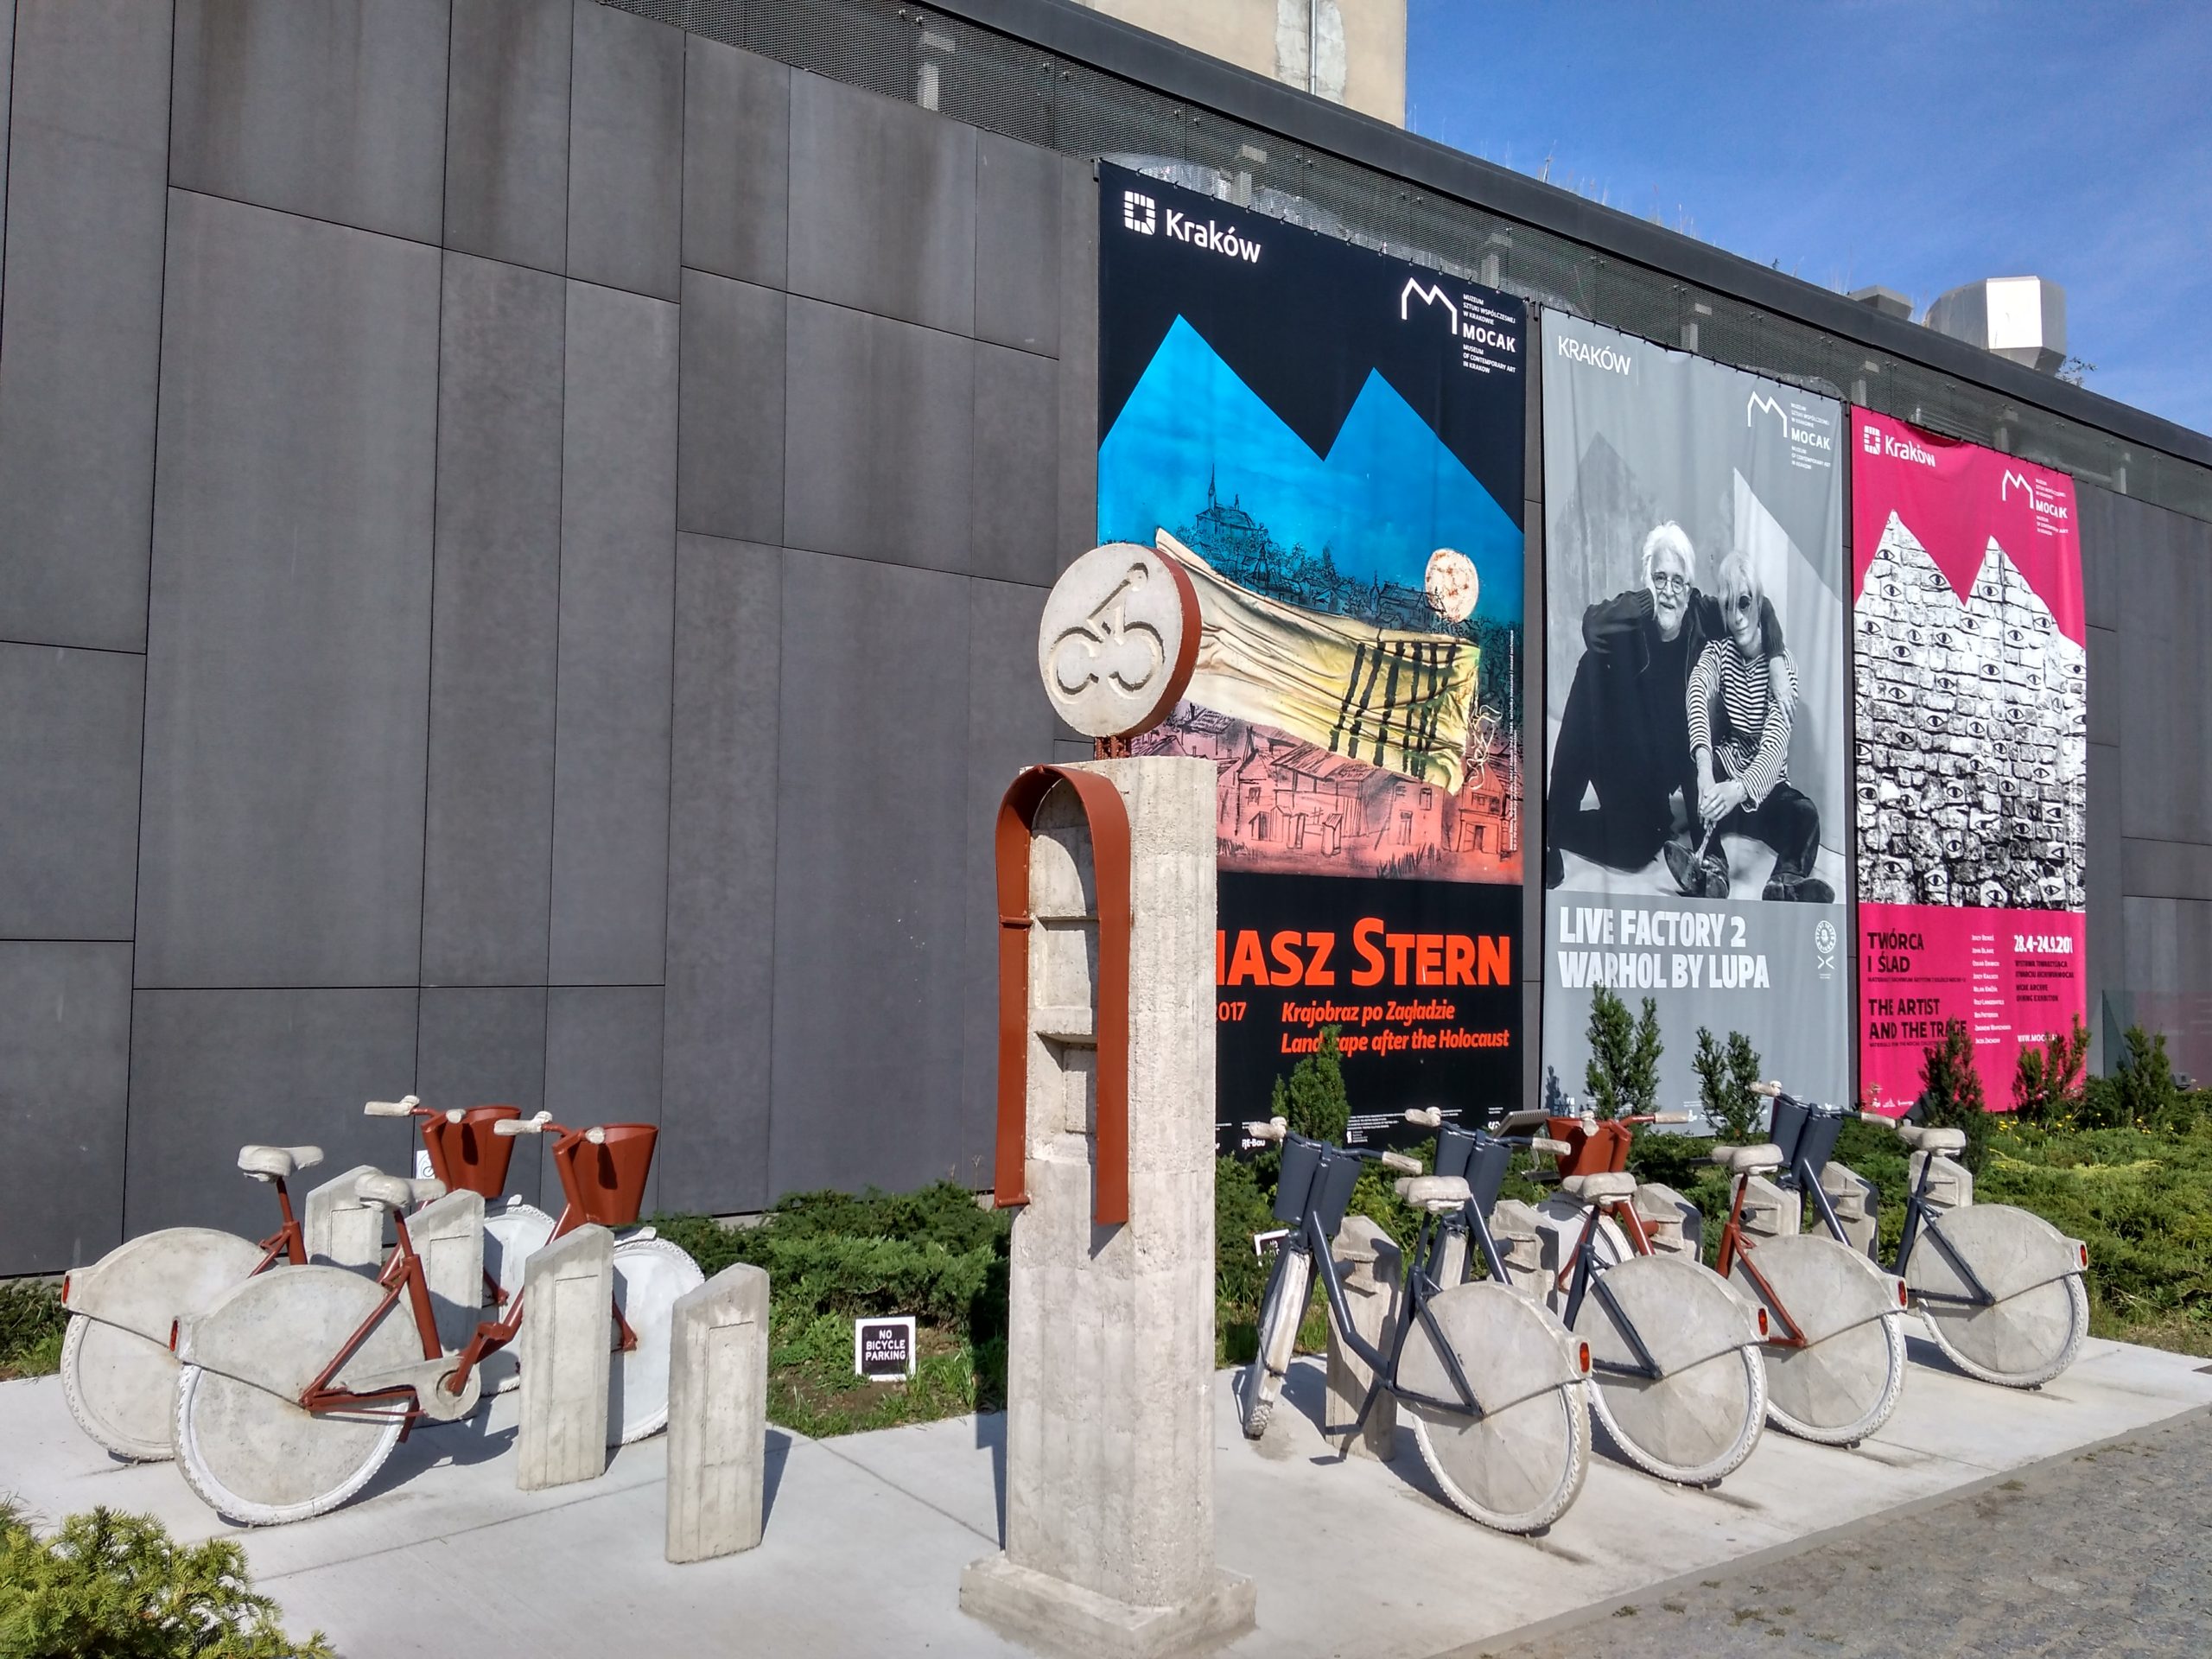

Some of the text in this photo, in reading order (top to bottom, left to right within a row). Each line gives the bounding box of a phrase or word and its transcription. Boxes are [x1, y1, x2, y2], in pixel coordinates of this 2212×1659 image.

[1166, 208, 1261, 264] Kraków
[1463, 322, 1516, 353] MOCAK
[1558, 335, 1630, 375] KRAKÓW
[1791, 428, 1831, 450] MOCAK
[1885, 435, 1936, 467] Kraków
[2036, 499, 2068, 518] MOCAK
[1560, 906, 1746, 948] LIVE FACTORY 2
[1867, 928, 1924, 950] TWÓRCA
[1558, 950, 1770, 988] WARHOL BY LUPA
[1867, 950, 1910, 973] I ŚLAD
[1217, 999, 1455, 1028] 017 Krajobraz po Zagładzie
[1868, 998, 1940, 1016] THE ARTIST
[1869, 1021, 1897, 1039] AND
[1901, 1021, 1927, 1039] THE
[1281, 1027, 1510, 1058] Landape after the Holocaust
[866, 1339, 906, 1350] BICYCLE
[880, 1330, 892, 1339] NO
[866, 1351, 906, 1361] PARKING
